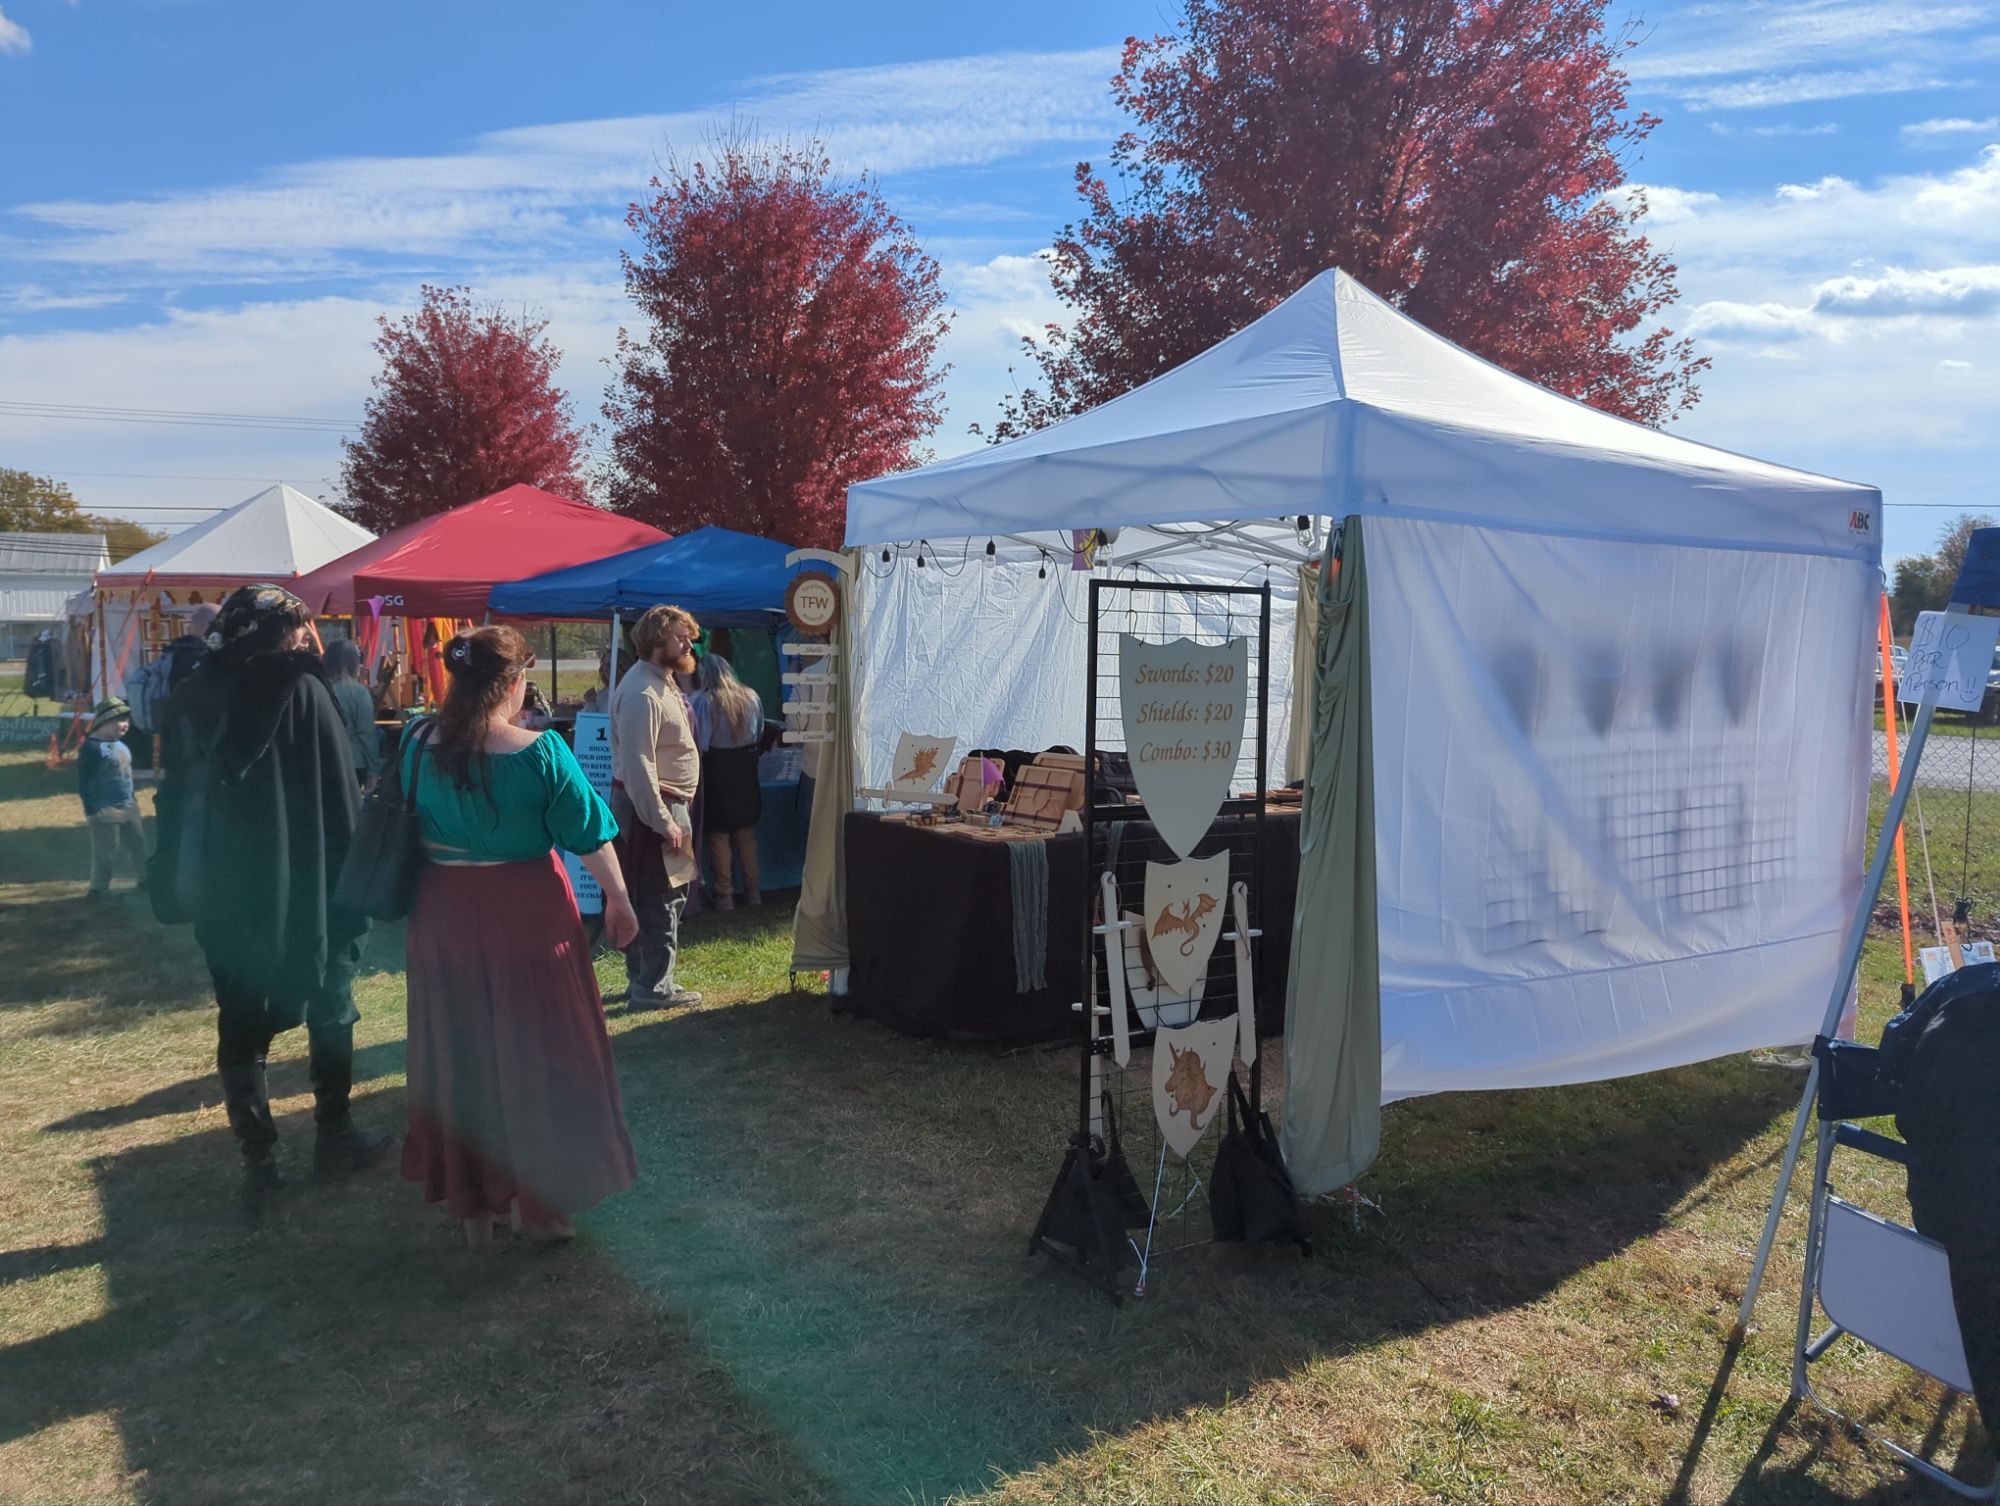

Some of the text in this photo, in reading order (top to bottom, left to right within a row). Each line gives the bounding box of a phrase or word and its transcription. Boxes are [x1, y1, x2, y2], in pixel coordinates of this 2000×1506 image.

[1849, 511, 1870, 530] ABC
[800, 596, 829, 609] TFW
[1912, 616, 1970, 651] $10
[1135, 662, 1234, 687] Swords: $20
[1136, 700, 1232, 724] Shields: $20
[596, 727, 607, 741] 1
[1139, 739, 1231, 763] Combo: $30
